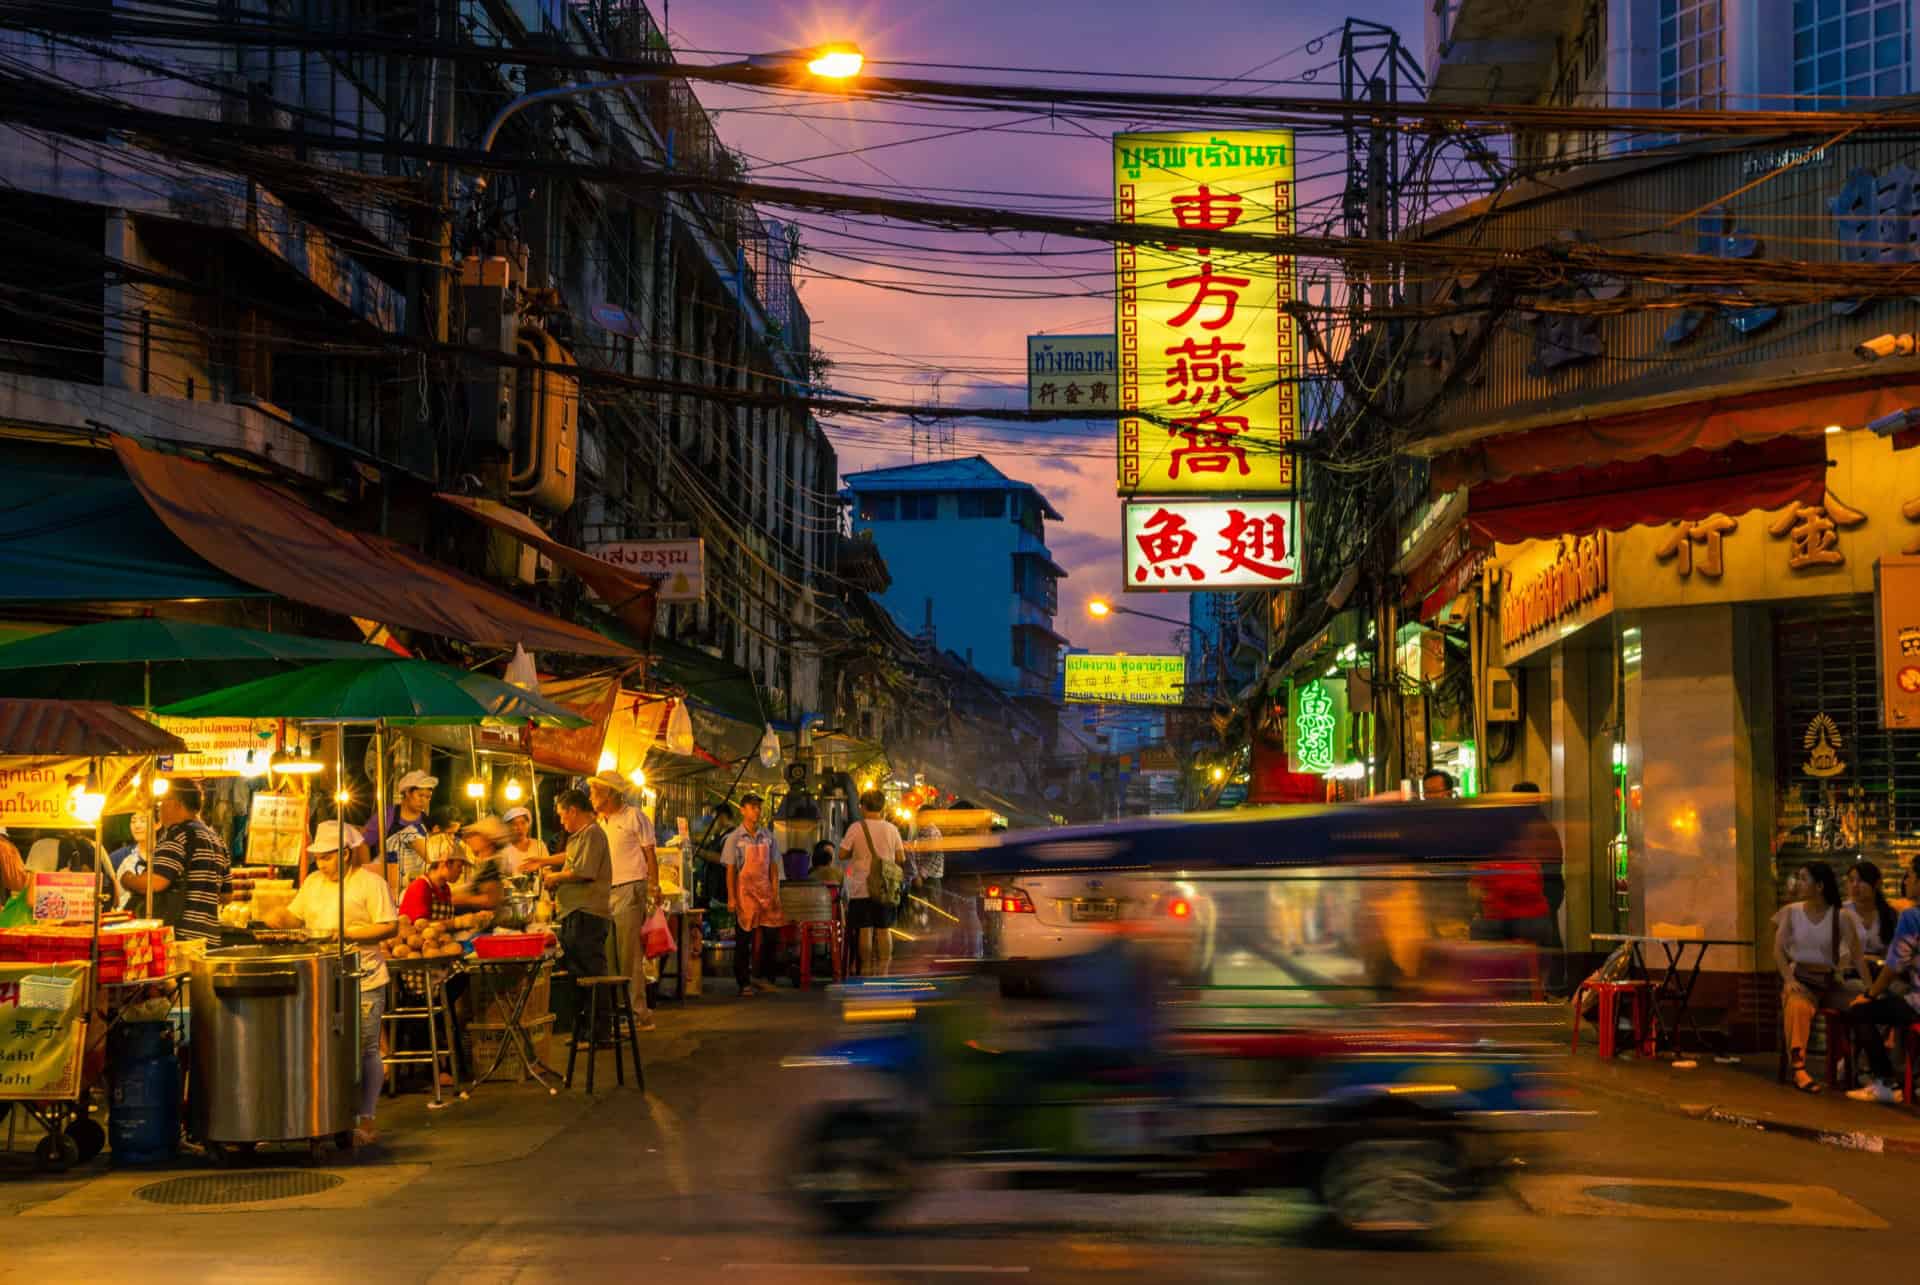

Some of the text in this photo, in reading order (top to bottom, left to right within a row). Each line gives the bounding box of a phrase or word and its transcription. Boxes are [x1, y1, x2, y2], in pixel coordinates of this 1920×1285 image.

[1121, 136, 1287, 178] บูรพารังนก
[1165, 184, 1251, 479] 東方燕窩
[1135, 507, 1295, 582] 魚翅
